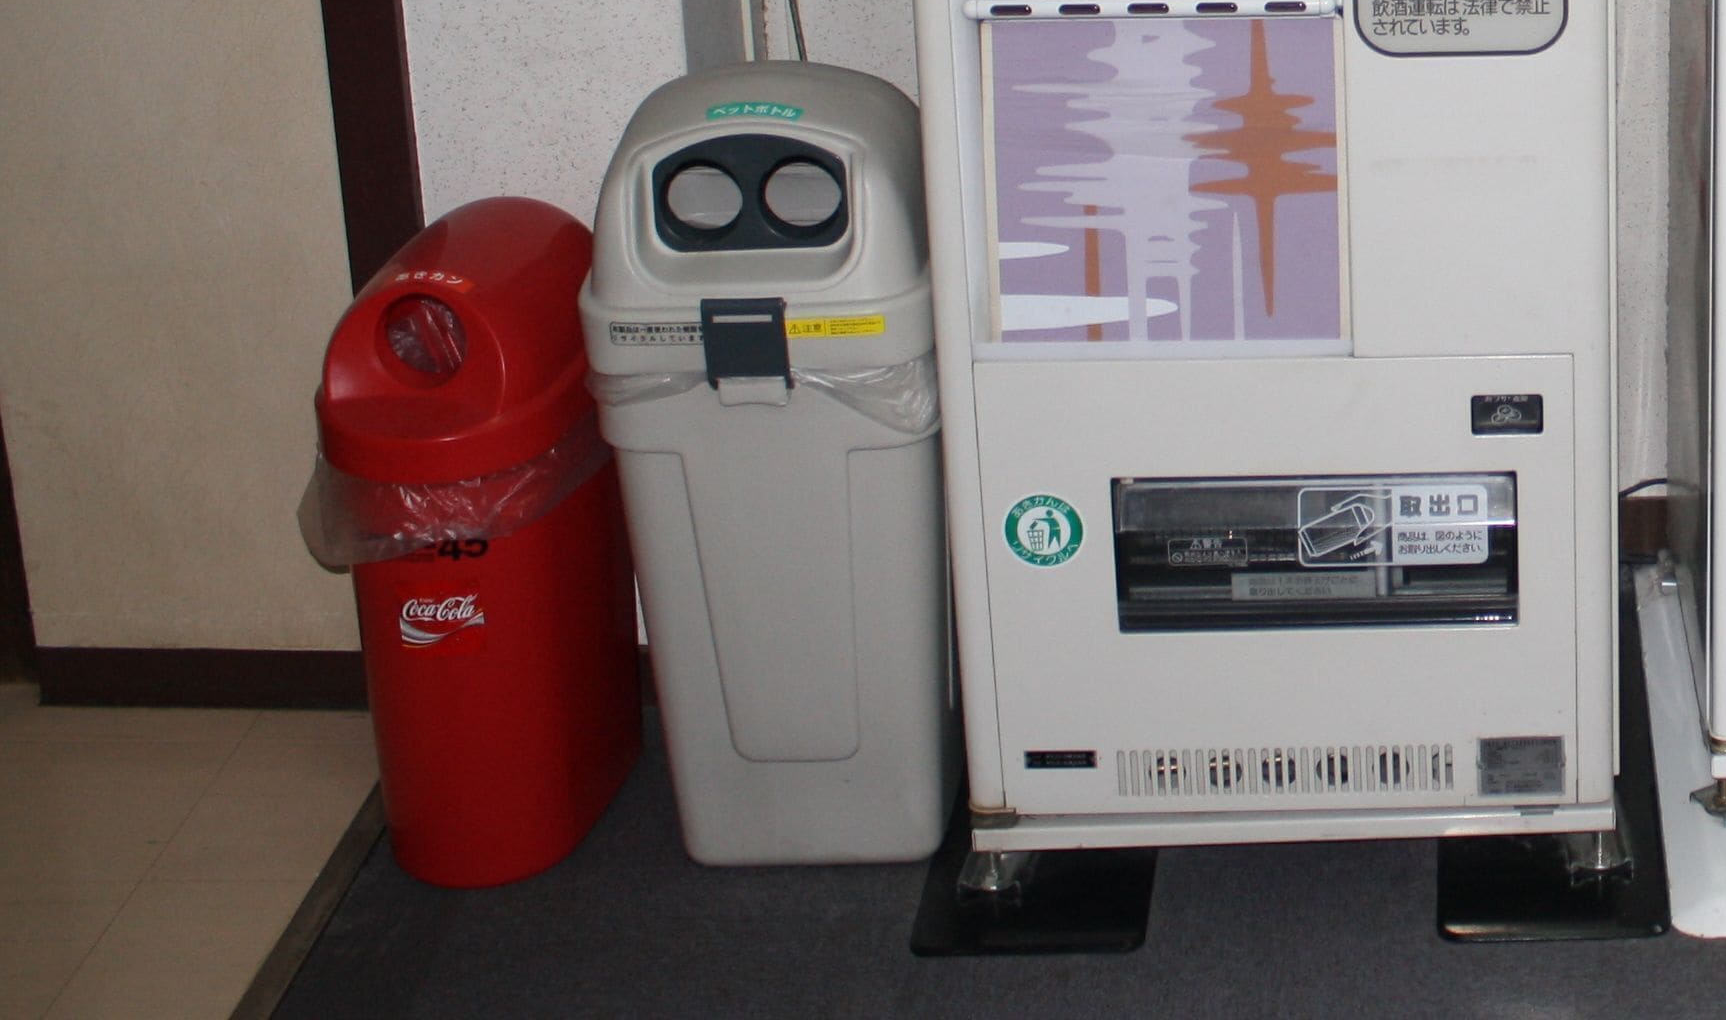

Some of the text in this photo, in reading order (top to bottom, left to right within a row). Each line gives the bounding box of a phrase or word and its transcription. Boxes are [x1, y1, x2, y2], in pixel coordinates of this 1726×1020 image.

[1373, 19, 1471, 36] されています。
[711, 102, 796, 119] ペットボトル
[1399, 494, 1479, 517] 取出口
[402, 592, 479, 622] Coca-Cola
